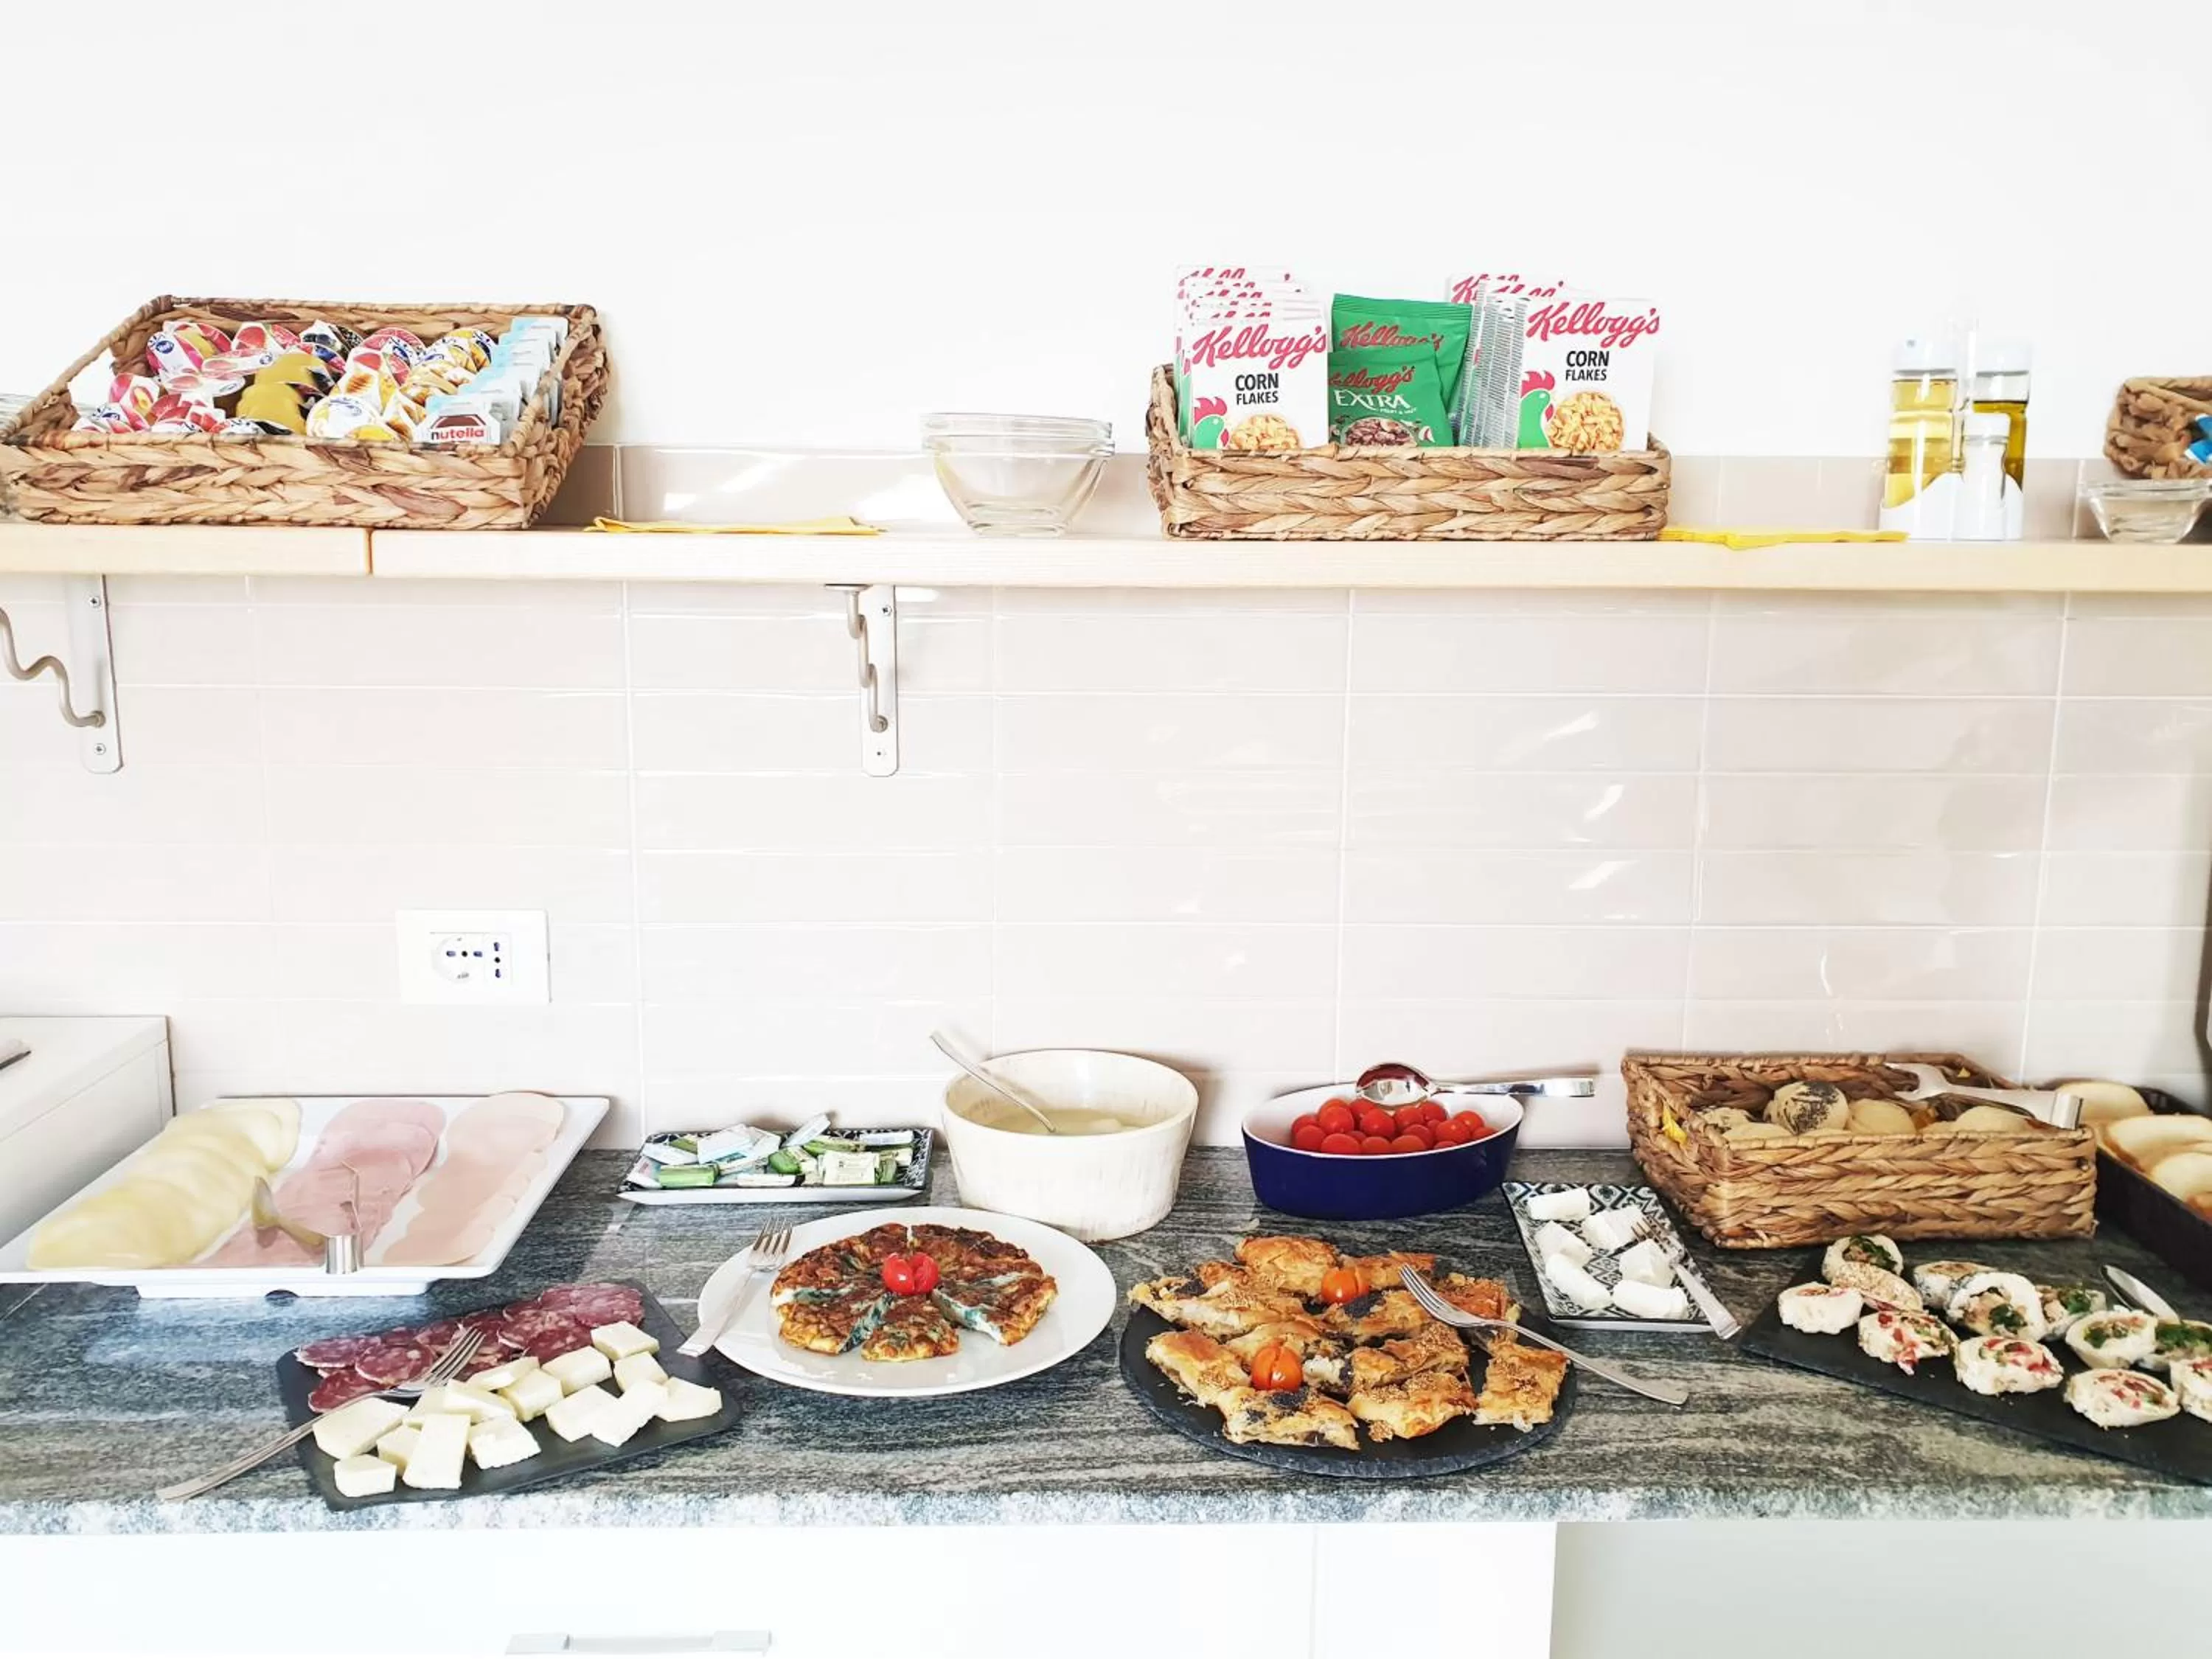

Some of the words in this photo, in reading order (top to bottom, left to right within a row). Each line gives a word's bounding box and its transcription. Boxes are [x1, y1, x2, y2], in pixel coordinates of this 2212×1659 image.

[1526, 302, 1660, 348] Kellogg's
[1192, 324, 1326, 369] Kellogg's
[1565, 350, 1610, 367] CORN
[1235, 373, 1279, 391] CORN
[1328, 365, 1416, 394] ellogg's
[1565, 369, 1607, 381] FLAKES
[1237, 391, 1279, 405] FLAKES
[1334, 389, 1412, 411] EXTRA
[431, 427, 485, 441] nutella
